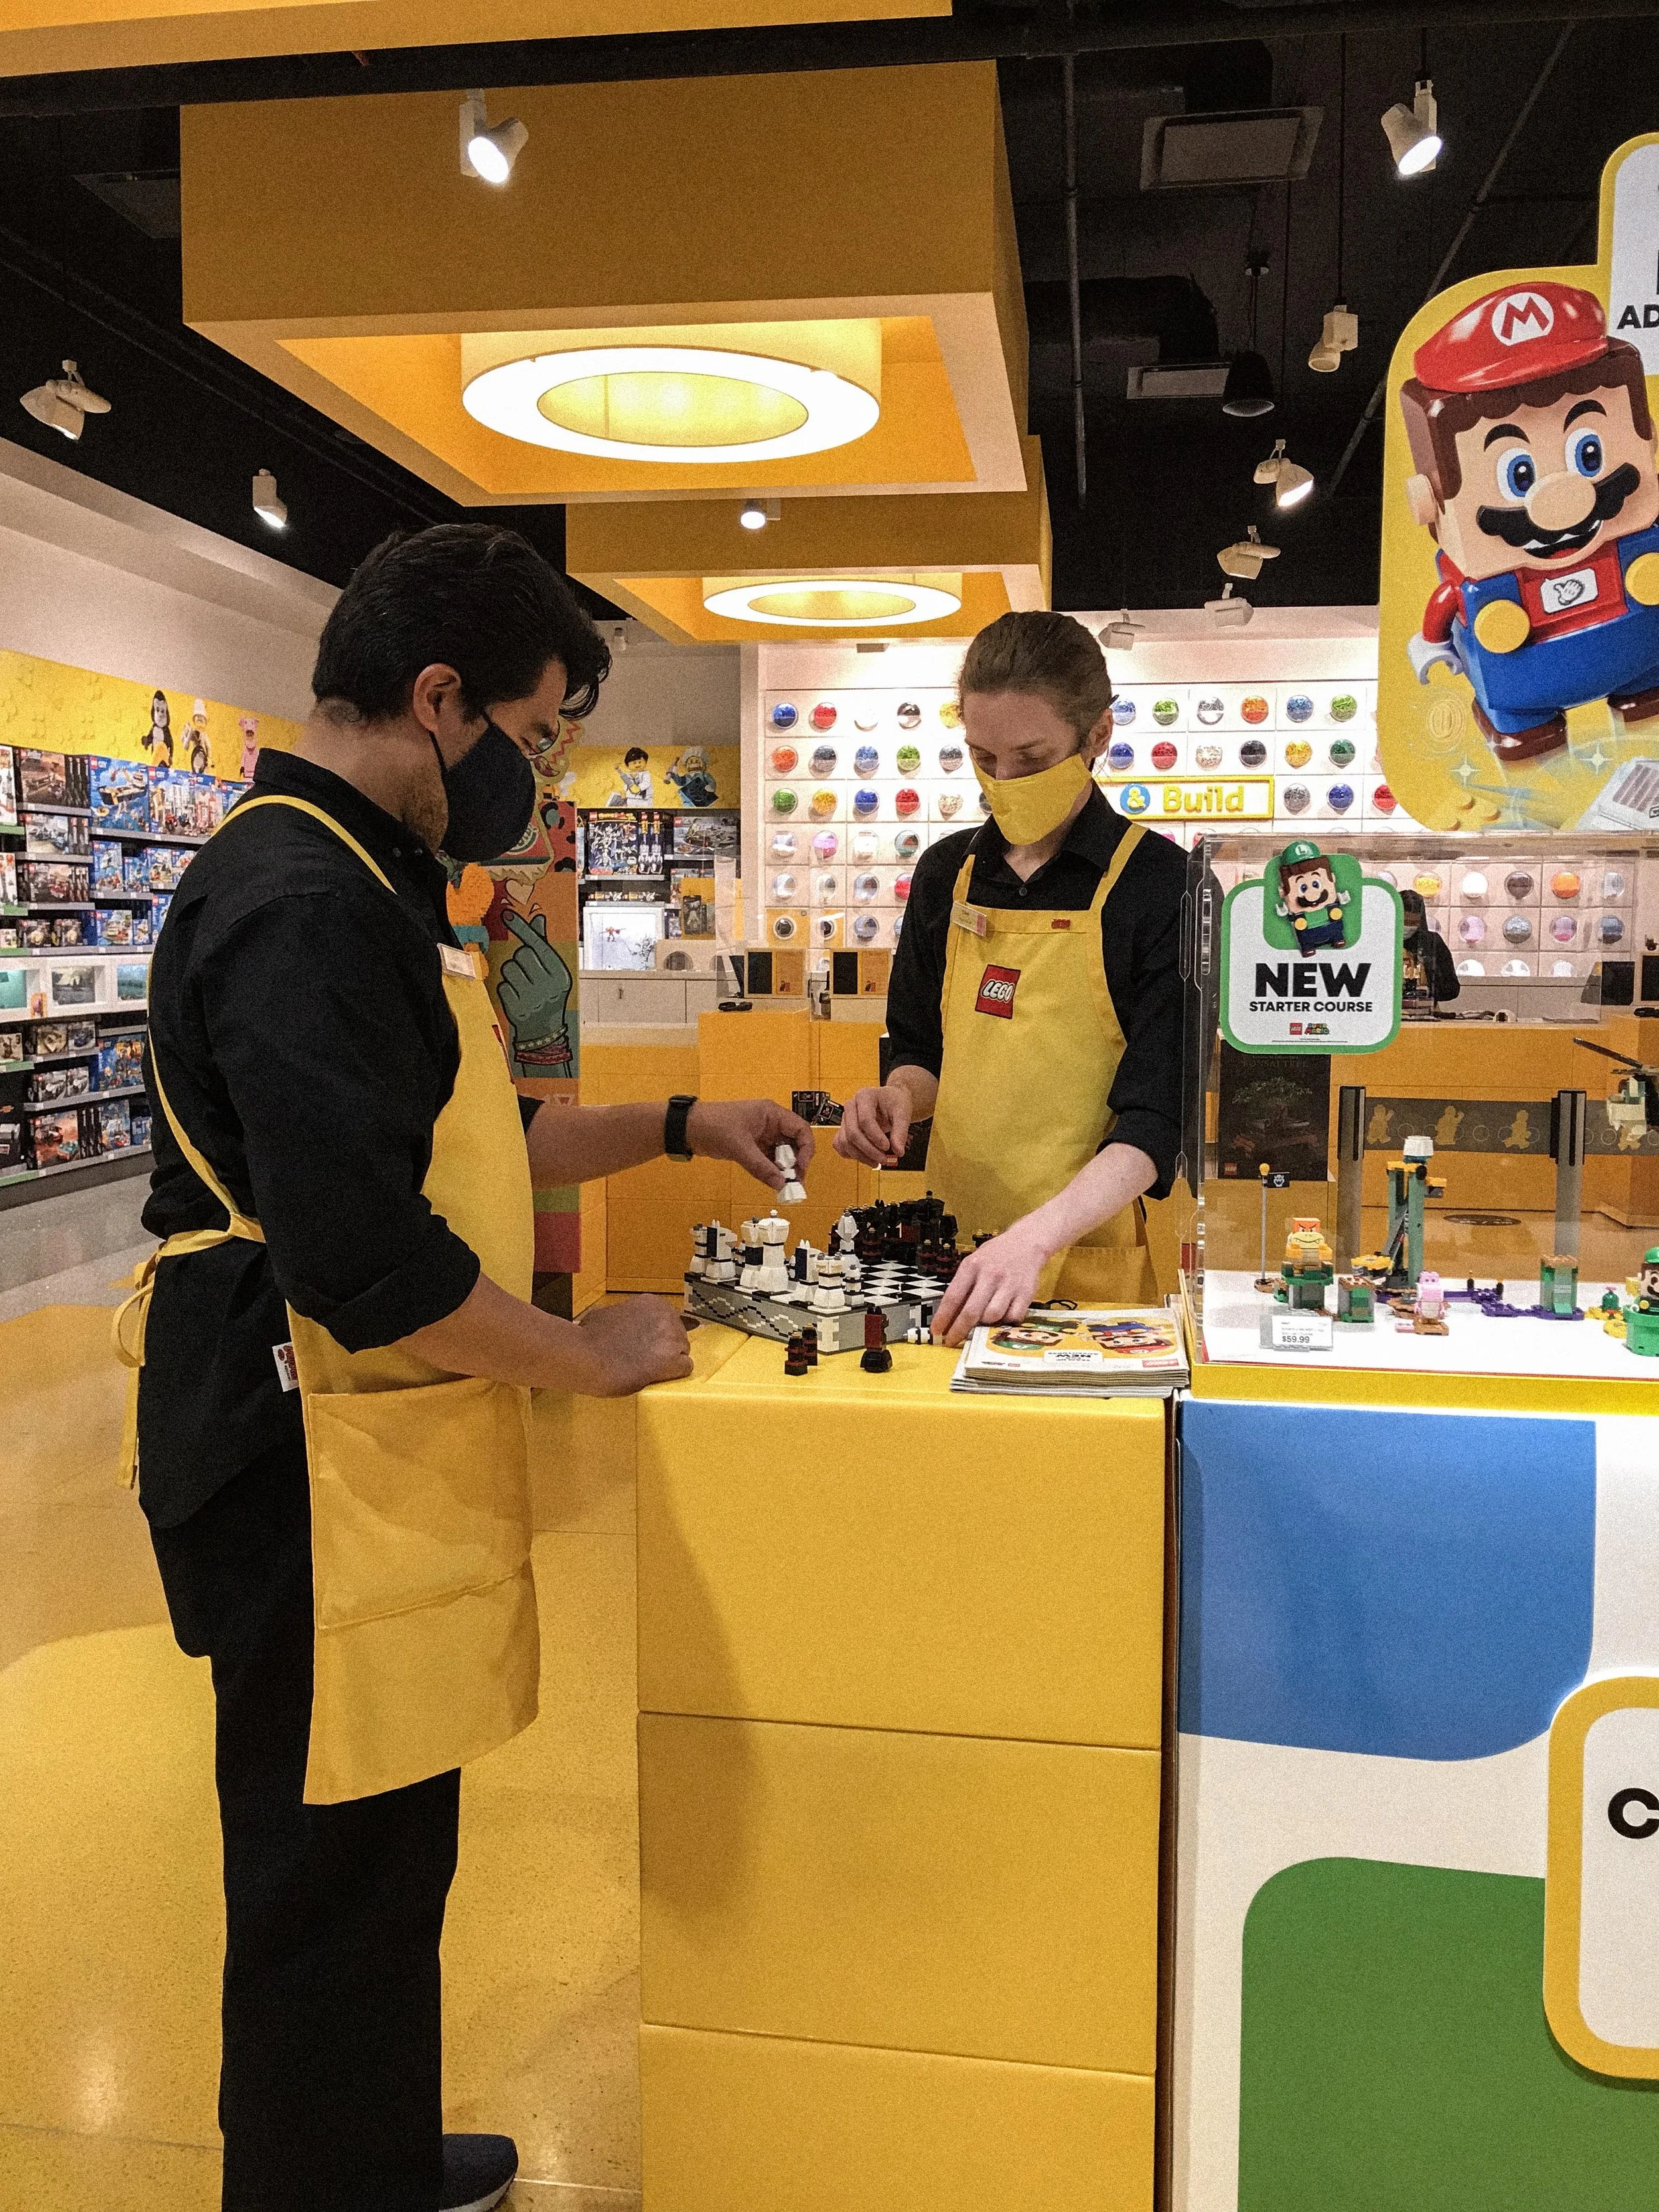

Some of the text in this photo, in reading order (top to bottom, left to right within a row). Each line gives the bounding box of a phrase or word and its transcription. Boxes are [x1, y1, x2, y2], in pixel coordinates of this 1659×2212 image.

[1127, 785, 1245, 812] & Build
[982, 979, 1015, 1003] LEGO
[1255, 963, 1372, 997] NEW
[1249, 1001, 1373, 1013] STARTER COURSE
[1608, 1787, 1659, 1839] C
